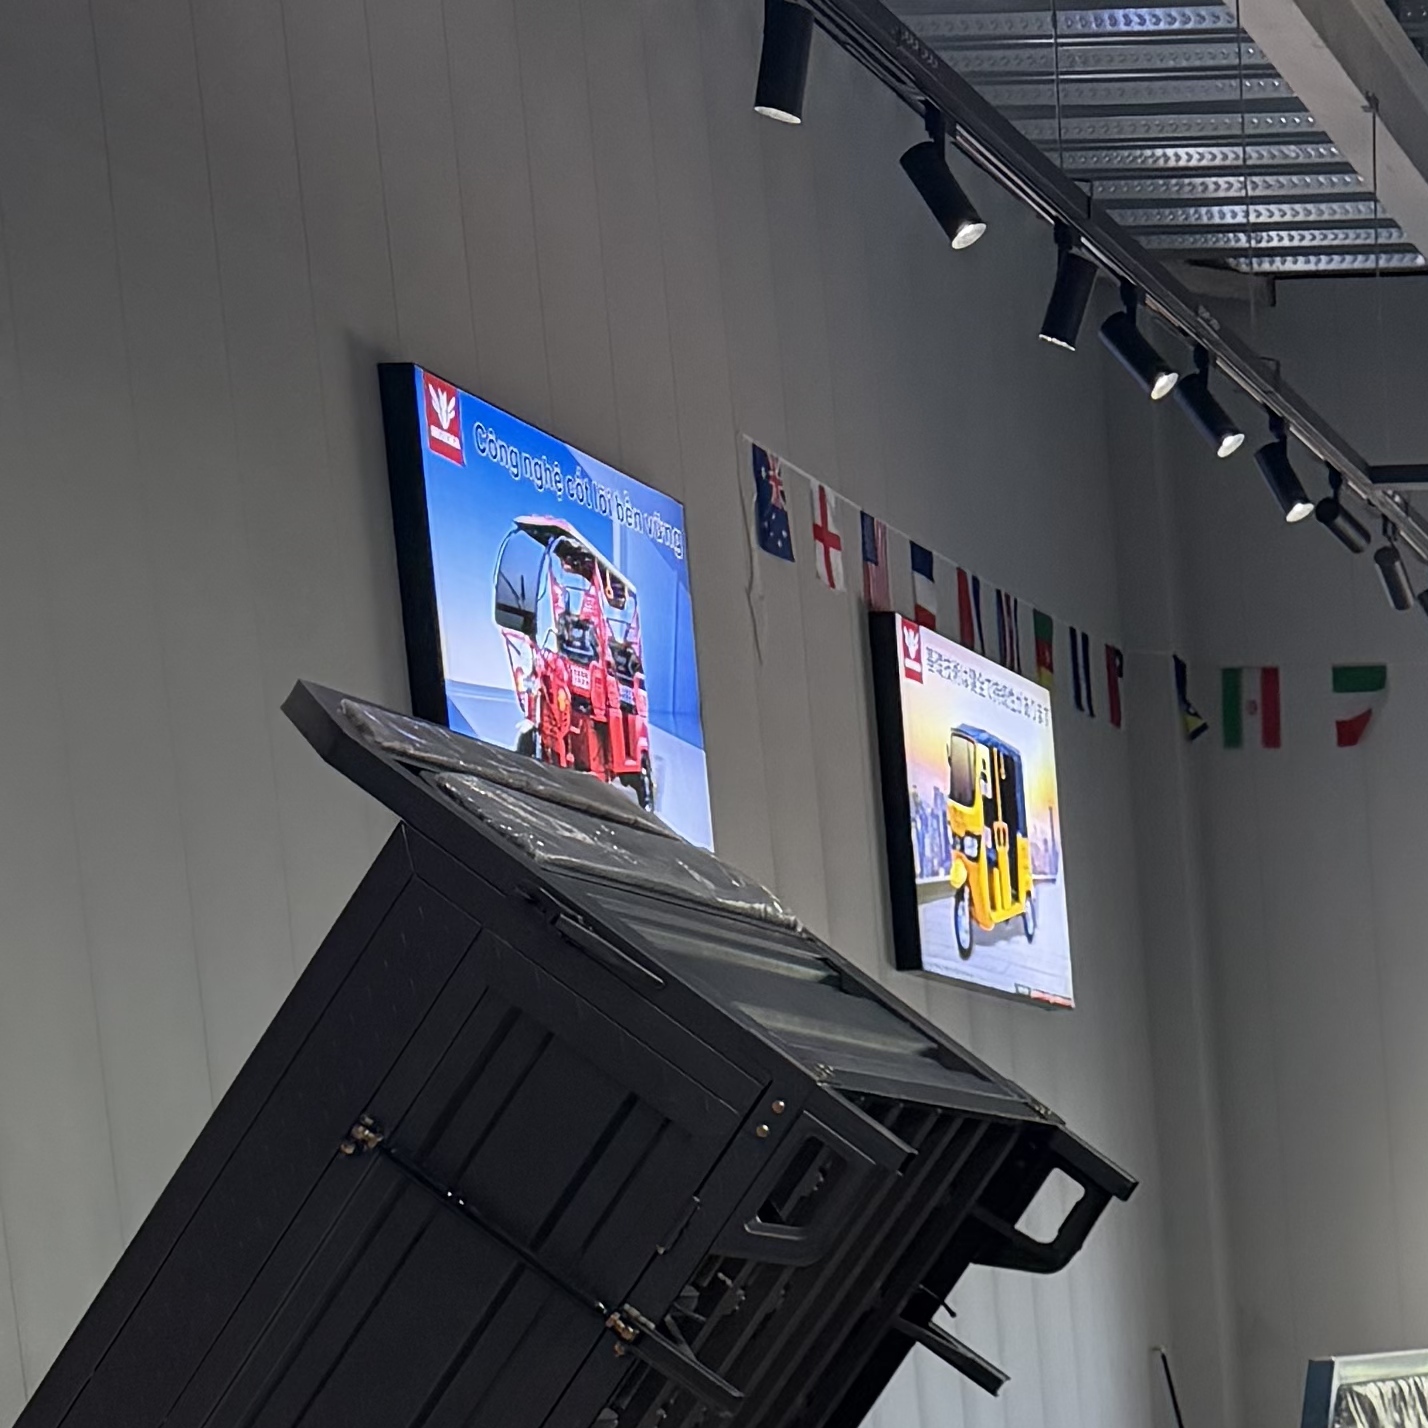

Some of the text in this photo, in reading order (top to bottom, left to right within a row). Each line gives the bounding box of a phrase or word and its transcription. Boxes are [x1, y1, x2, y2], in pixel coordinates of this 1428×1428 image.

[473, 422, 521, 480] Công
[522, 452, 563, 502] nghệ
[566, 466, 592, 509] cốt
[592, 478, 613, 517] lõi
[614, 489, 644, 532] bền
